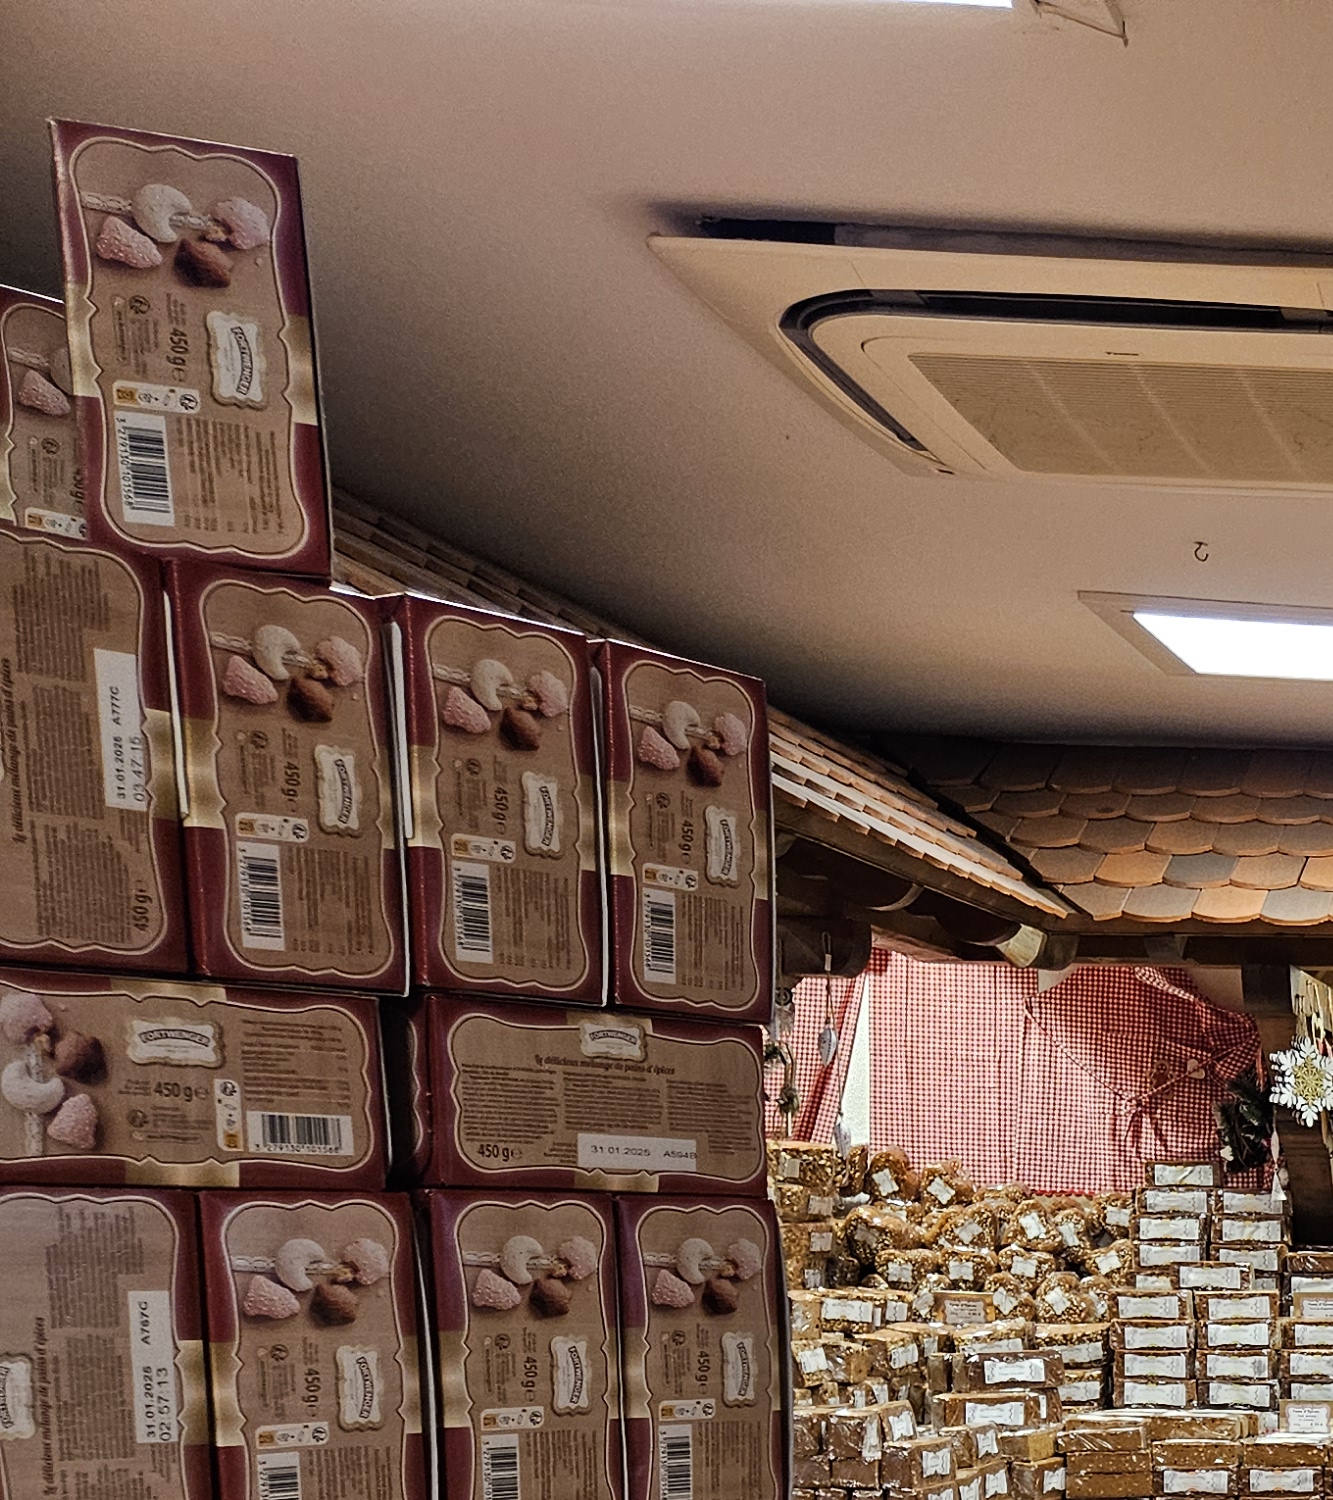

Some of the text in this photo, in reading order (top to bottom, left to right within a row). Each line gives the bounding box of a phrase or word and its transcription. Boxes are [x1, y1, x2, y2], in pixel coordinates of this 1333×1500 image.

[230, 327, 252, 396] FORTWENGER
[538, 786, 552, 847] FORTWENGER
[139, 1029, 211, 1047] FORTWENGER
[355, 1357, 372, 1419] FORTWENGER
[567, 1346, 581, 1404] FORTWENGER
